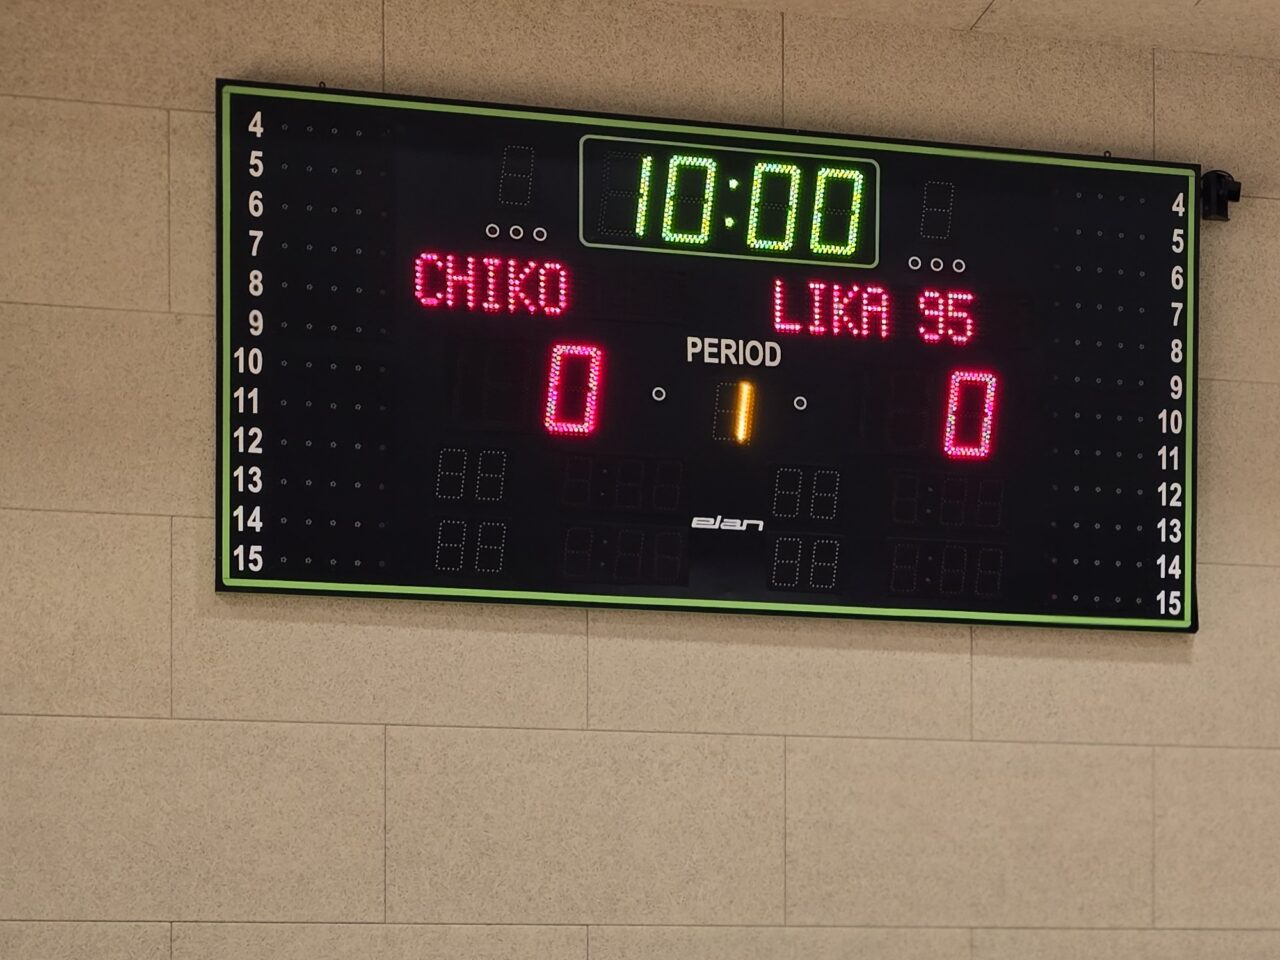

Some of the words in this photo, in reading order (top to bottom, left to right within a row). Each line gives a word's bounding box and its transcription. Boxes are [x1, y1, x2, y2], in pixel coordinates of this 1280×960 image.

[249, 112, 263, 137] 4
[249, 151, 264, 177] 5
[249, 191, 263, 217] 6
[635, 155, 864, 256] 10:00
[1172, 193, 1185, 216] 4
[249, 230, 264, 256] 7
[1172, 229, 1184, 253] 5
[249, 270, 263, 296] 8
[414, 252, 569, 316] CHIKO
[1172, 266, 1184, 289] 6
[249, 310, 263, 335] 9
[773, 279, 890, 339] LIKA
[918, 289, 974, 345] 95
[1172, 302, 1183, 326] 7
[234, 347, 263, 374] 10
[687, 337, 781, 367] PERIOD
[1171, 339, 1183, 362] 8
[234, 387, 259, 413] 11
[545, 344, 602, 436] 0
[1170, 376, 1183, 399] 9
[734, 381, 755, 444] 1
[944, 369, 997, 459] 0
[1158, 409, 1182, 433] 10
[233, 427, 263, 453] 12
[1158, 446, 1180, 470] 11
[233, 466, 263, 493] 13
[1157, 482, 1182, 506] 12
[233, 506, 263, 532] 14
[691, 515, 764, 531] elan
[1157, 518, 1181, 543] 13
[233, 545, 263, 571] 15
[1157, 554, 1181, 579] 14
[1157, 590, 1181, 615] 15
